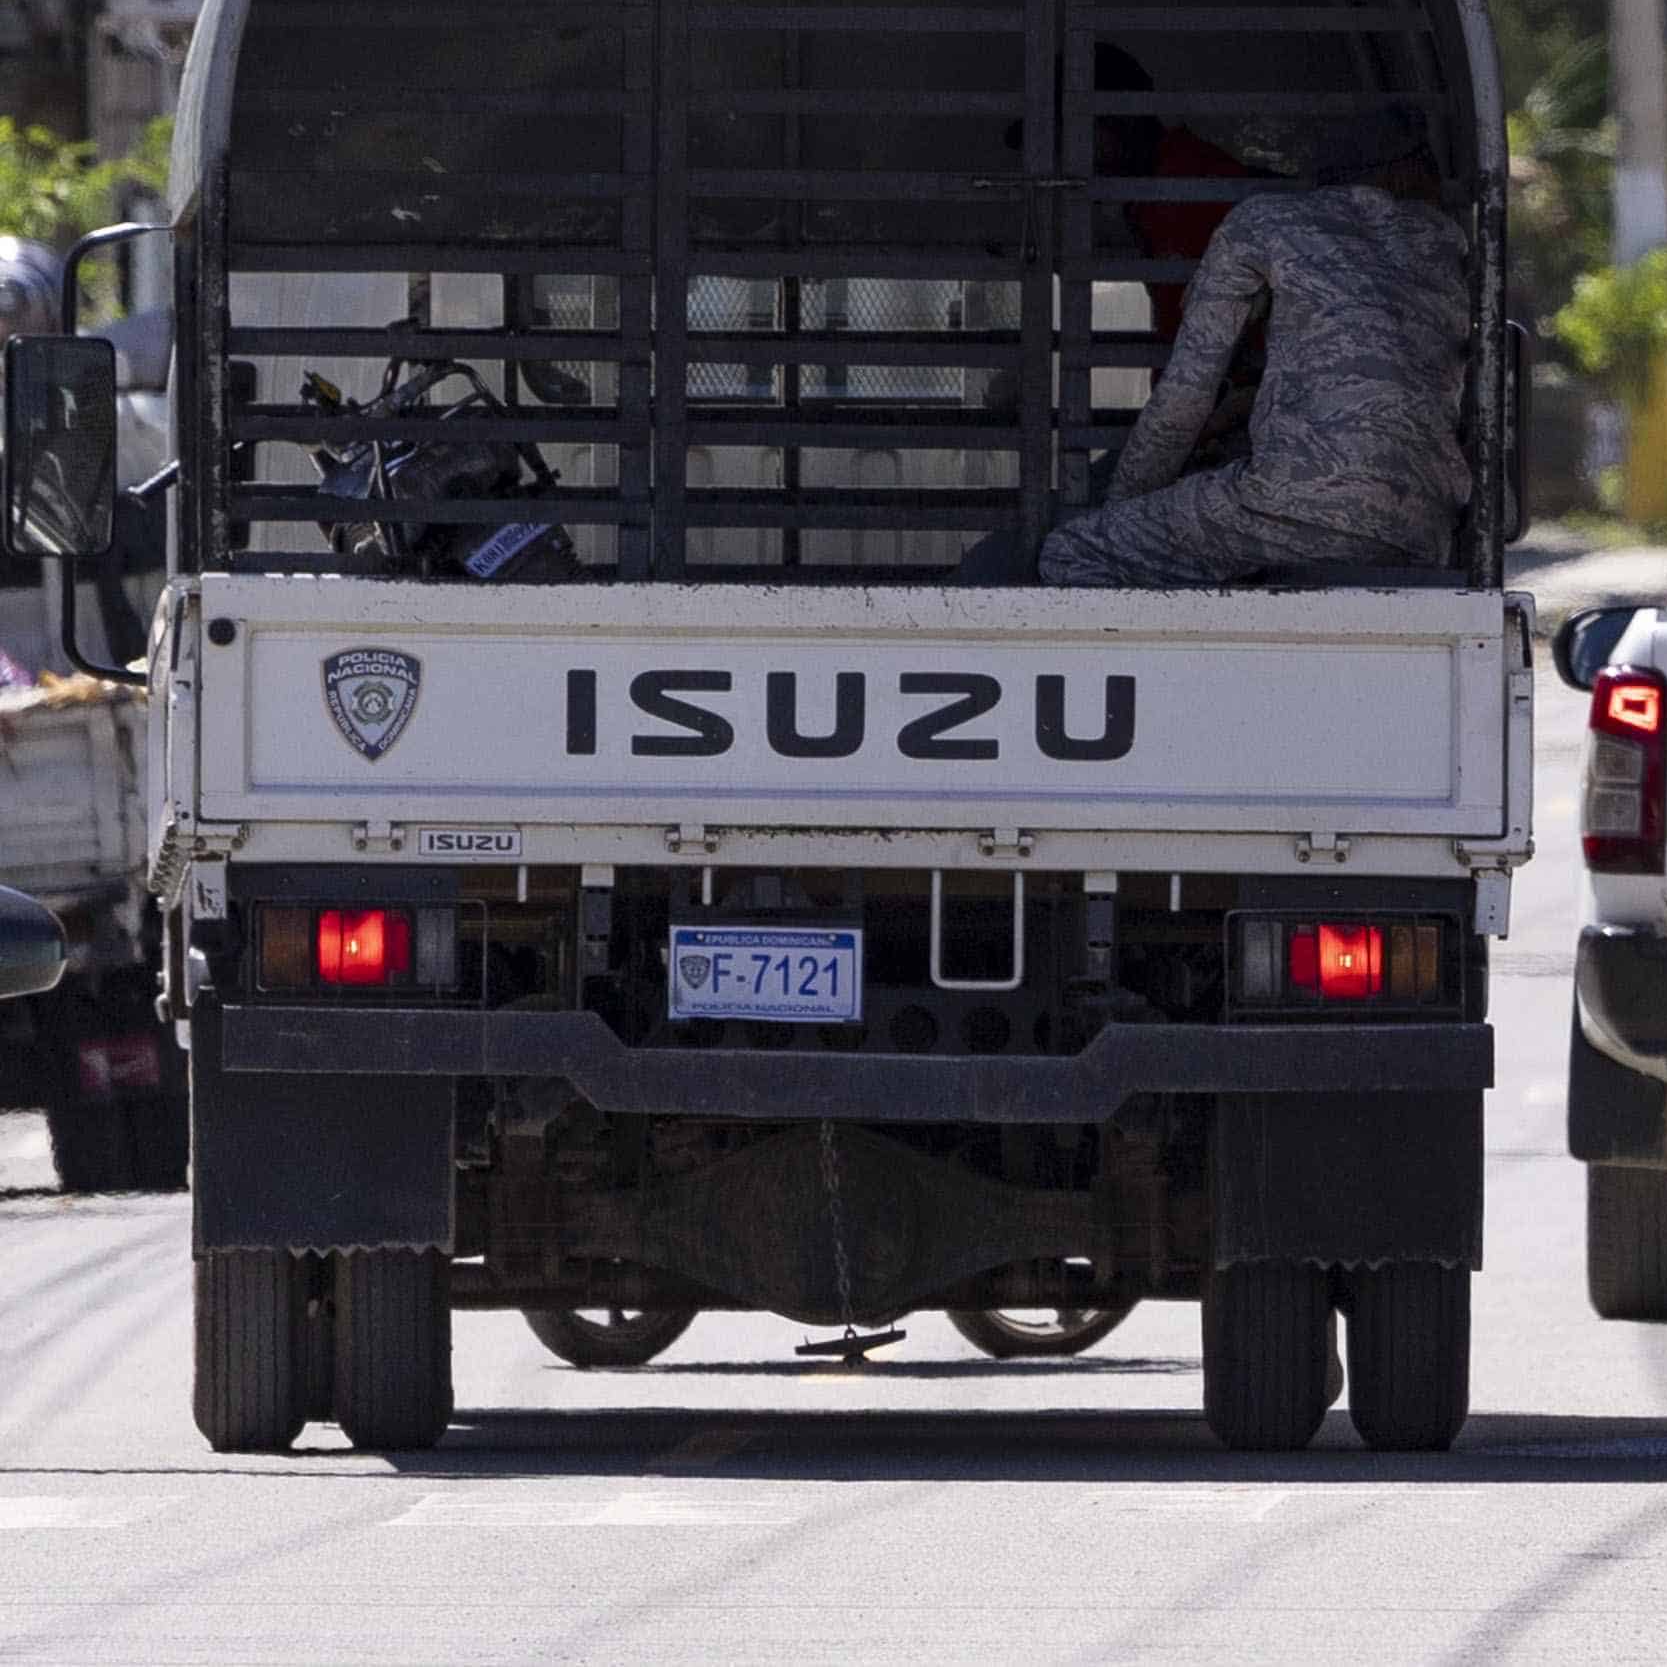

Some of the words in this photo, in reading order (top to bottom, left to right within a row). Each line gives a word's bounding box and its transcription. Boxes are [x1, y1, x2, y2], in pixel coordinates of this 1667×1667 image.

[338, 652, 408, 668] POLICIA
[327, 663, 418, 686] NACIONAL
[566, 669, 1137, 762] ISUZU
[428, 833, 513, 851] ISUZU
[712, 953, 838, 998] F-7121
